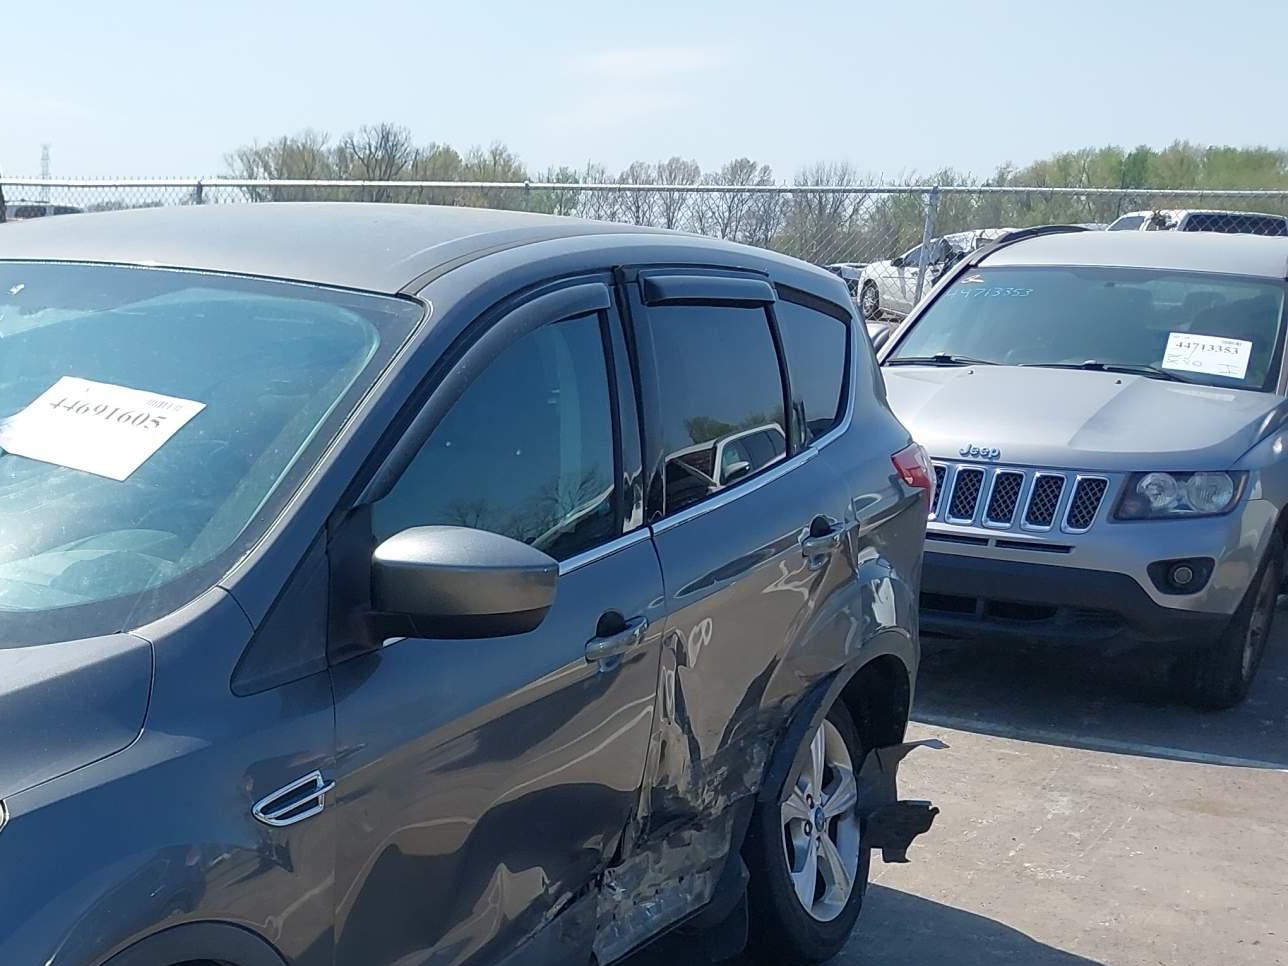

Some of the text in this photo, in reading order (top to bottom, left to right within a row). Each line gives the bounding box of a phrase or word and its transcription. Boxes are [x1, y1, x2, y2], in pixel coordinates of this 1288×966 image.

[1175, 341, 1239, 355] 44713353
[49, 397, 168, 430] 44691605
[959, 442, 1001, 460] Jeep
